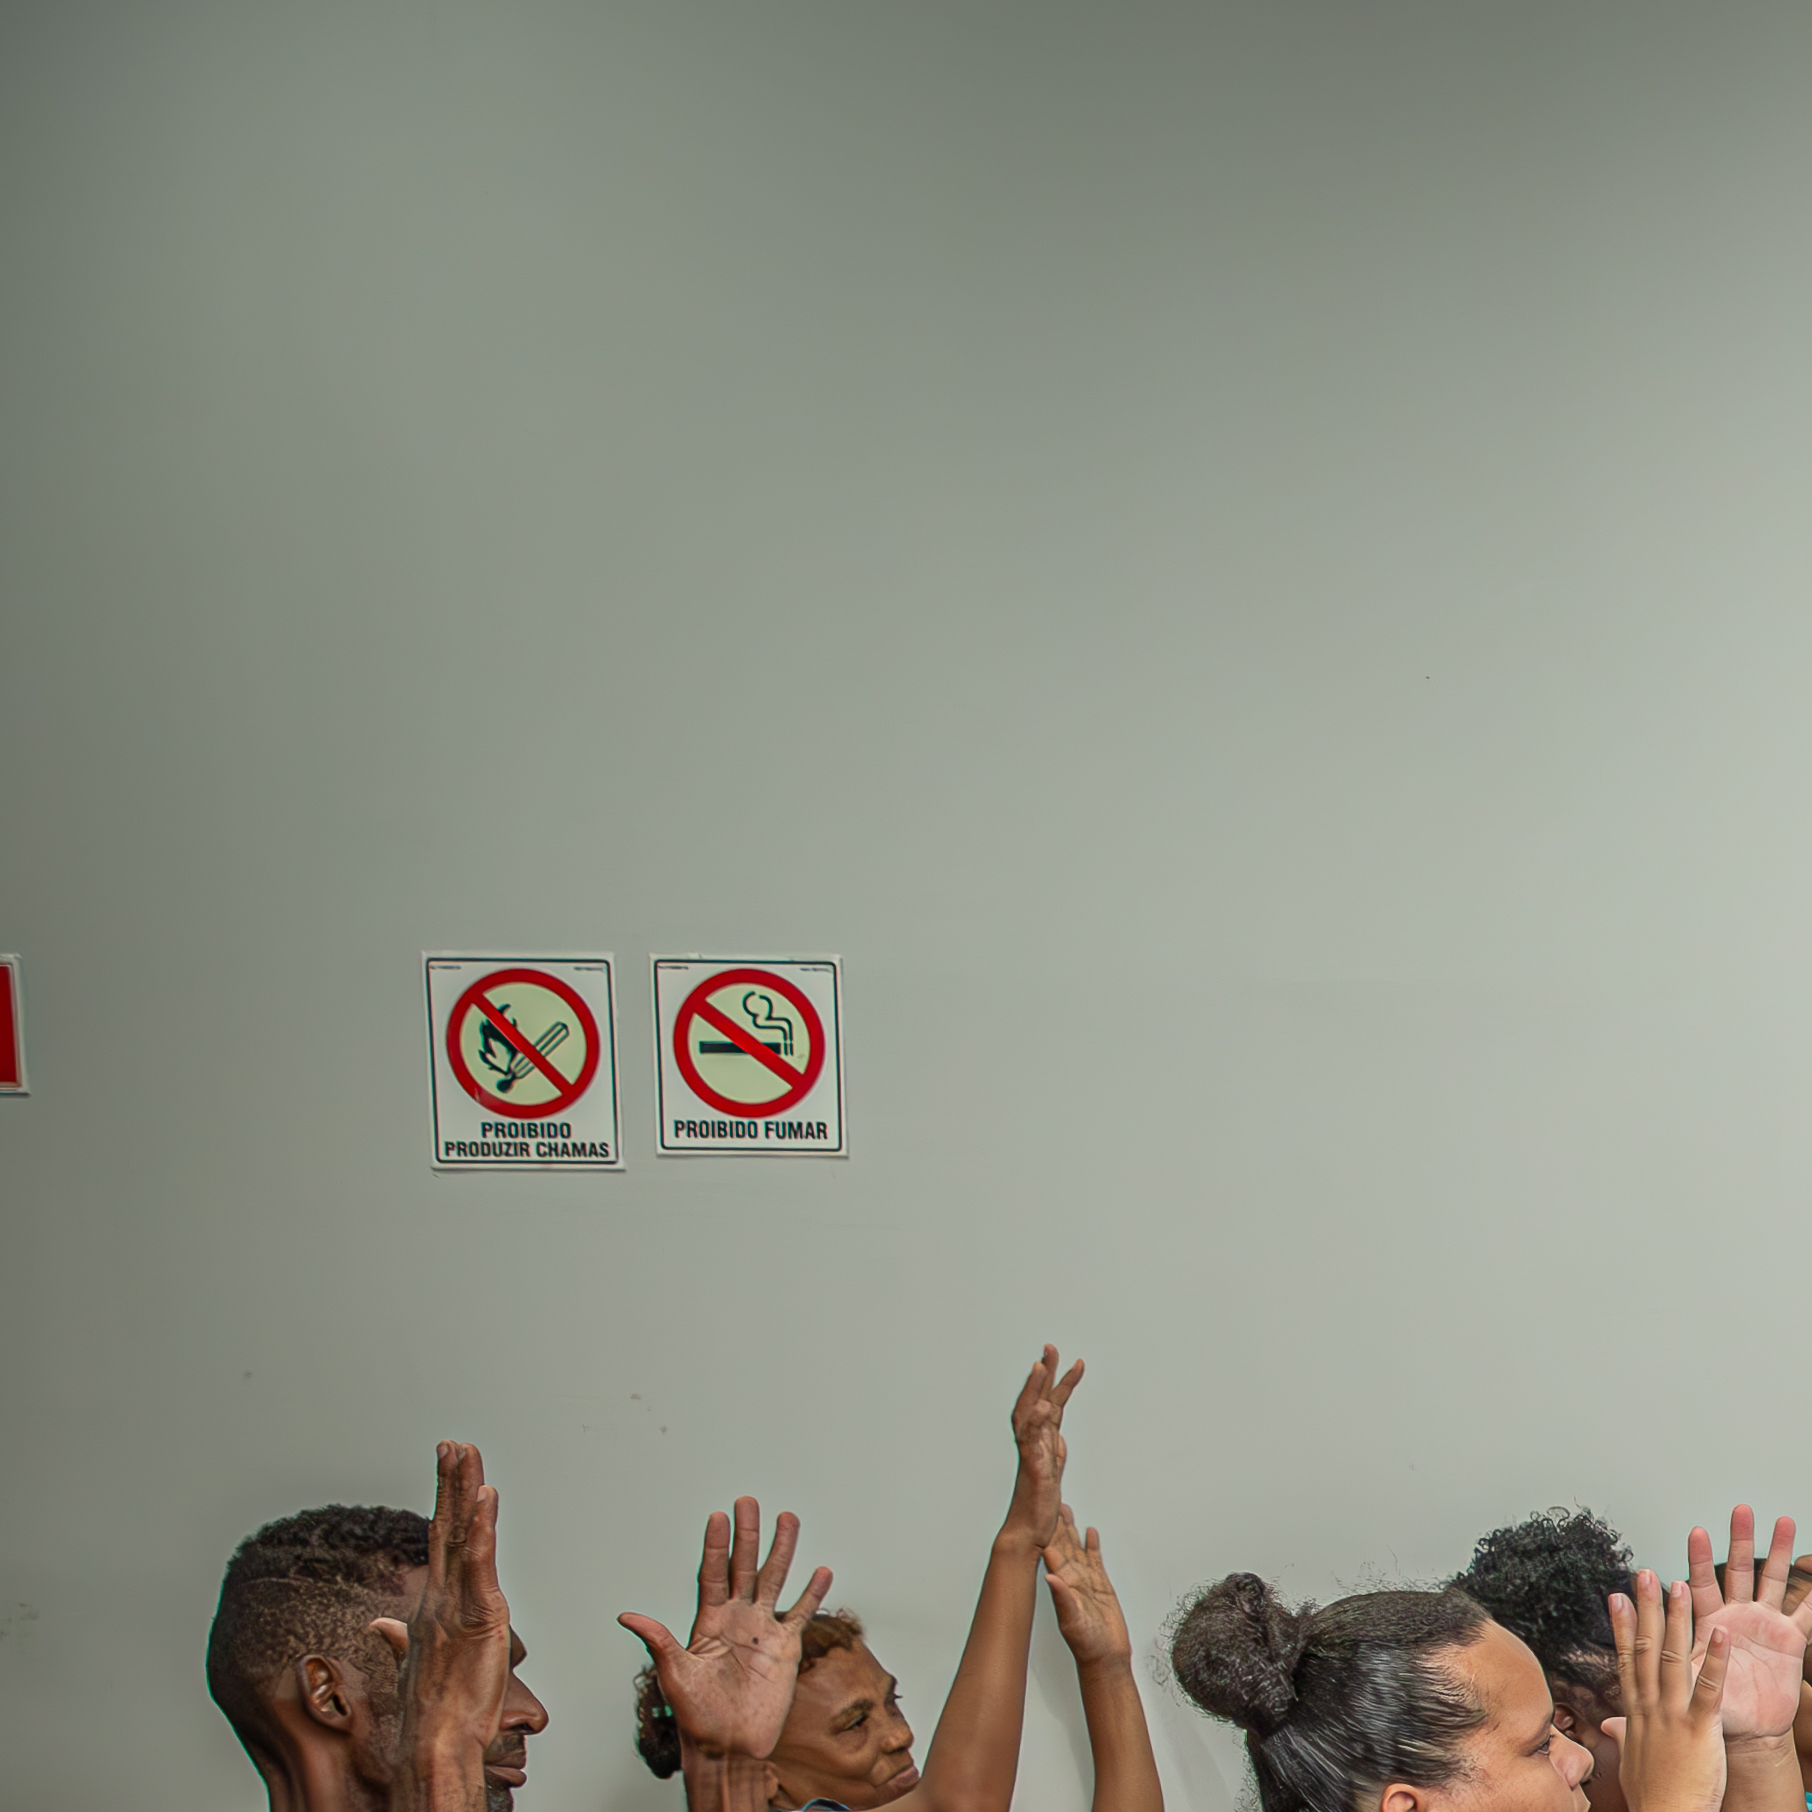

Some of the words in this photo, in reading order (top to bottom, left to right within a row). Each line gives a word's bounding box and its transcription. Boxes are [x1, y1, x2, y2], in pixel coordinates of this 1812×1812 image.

[480, 1121, 572, 1140] PROIBIDO
[673, 1119, 759, 1140] PROIBIDO
[763, 1120, 828, 1140] FUMAR
[444, 1140, 531, 1158] PRODUZIR
[535, 1141, 610, 1159] CHAMAS
